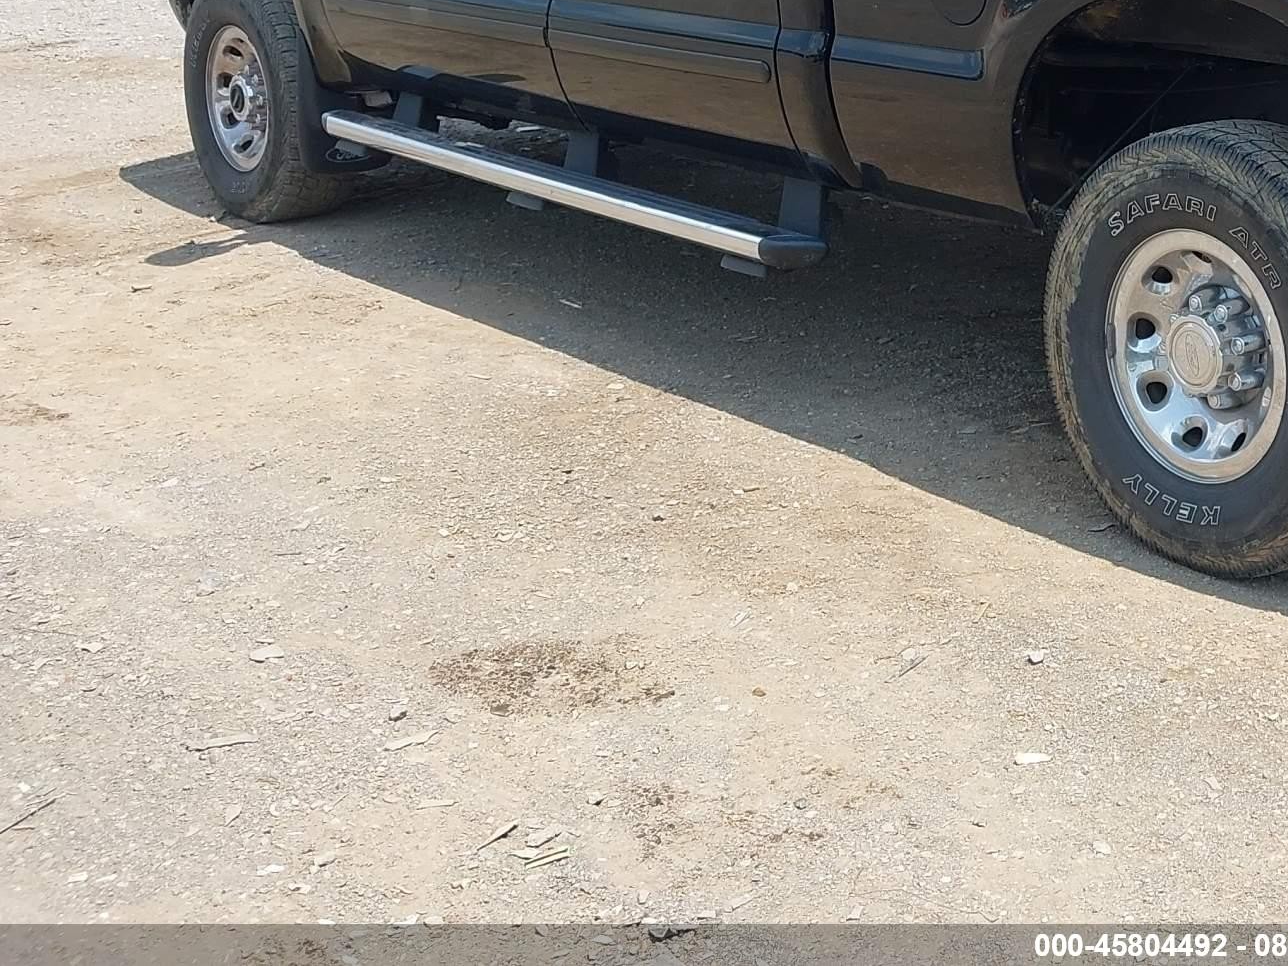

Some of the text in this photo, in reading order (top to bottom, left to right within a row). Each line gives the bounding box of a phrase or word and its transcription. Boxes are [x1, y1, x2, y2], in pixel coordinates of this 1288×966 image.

[1108, 193, 1282, 290] SAFARI ATR
[1122, 474, 1221, 526] KELLY
